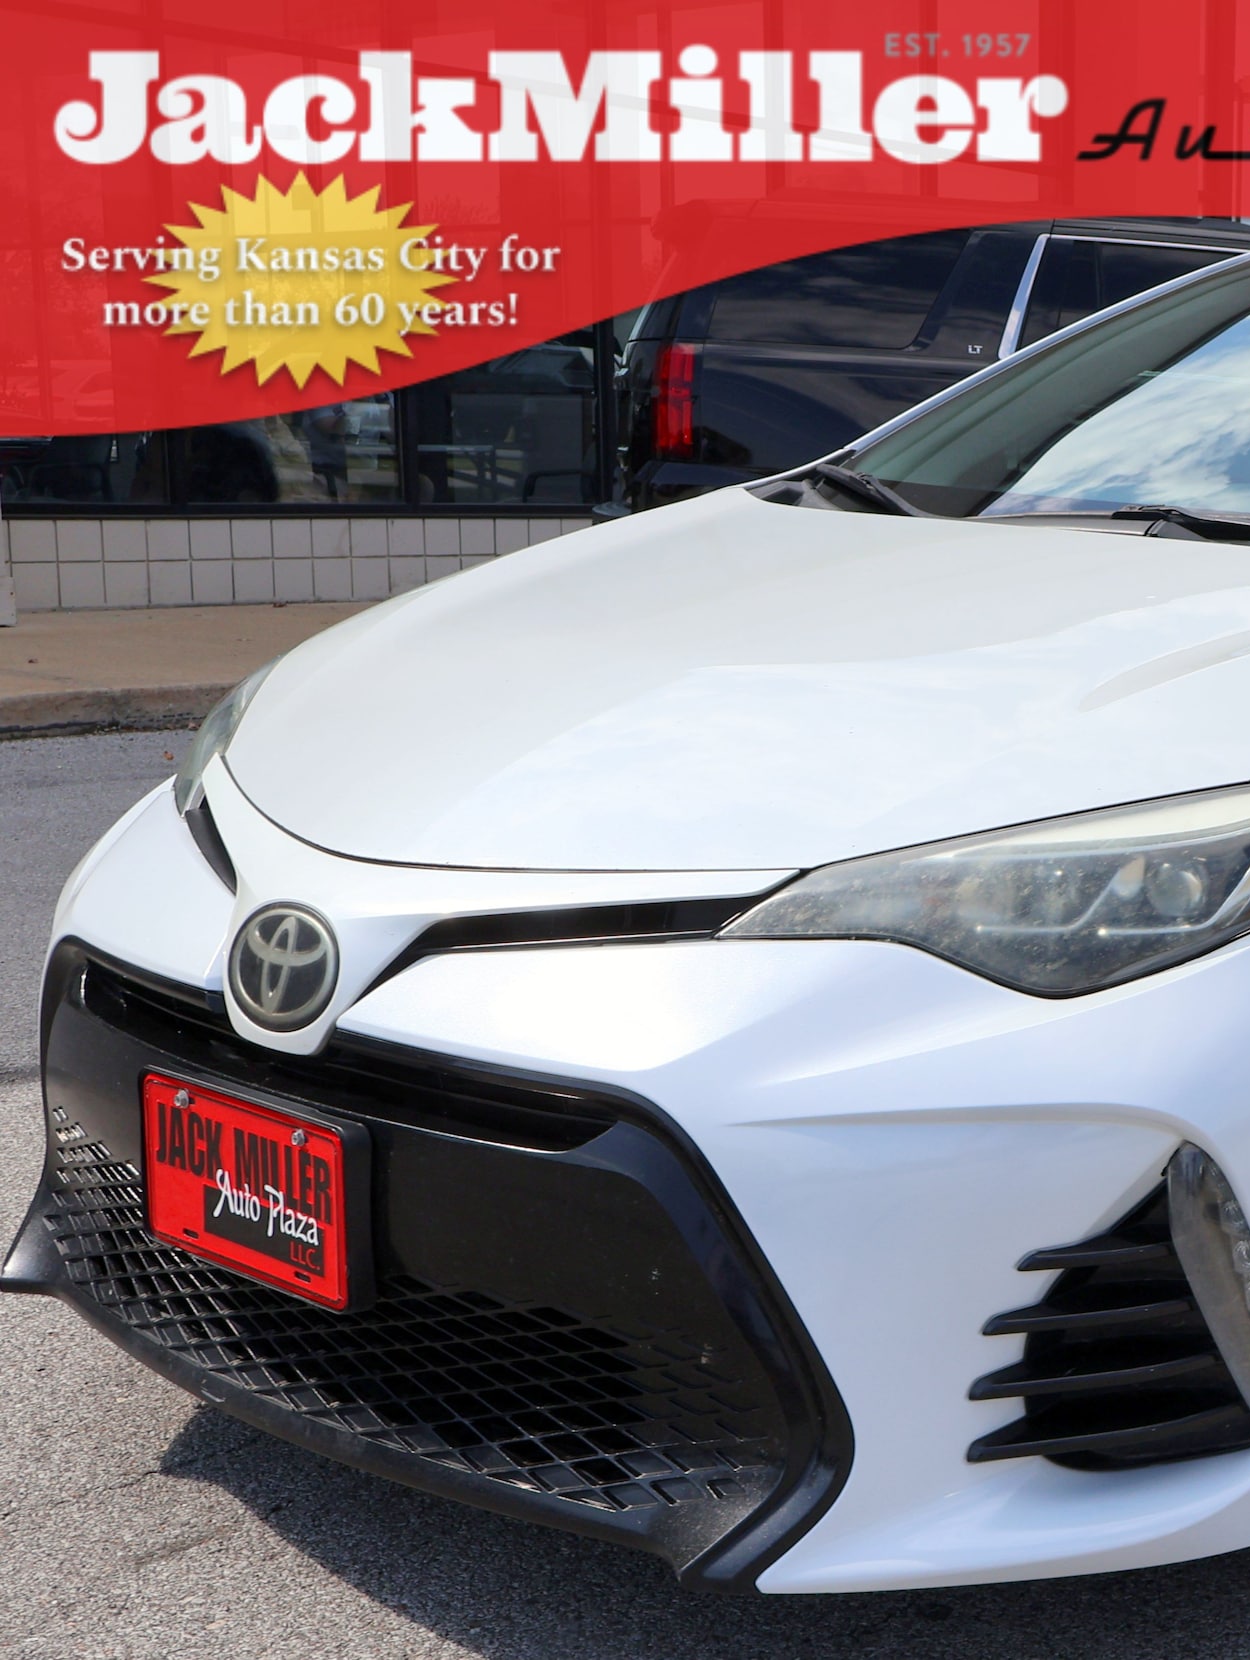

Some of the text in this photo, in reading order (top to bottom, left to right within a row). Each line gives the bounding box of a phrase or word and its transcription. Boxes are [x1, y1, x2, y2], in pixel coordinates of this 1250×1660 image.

[967, 344, 983, 354] LT
[156, 1102, 333, 1225] JACK MILLER
[212, 1168, 320, 1247] Auto Plaza
